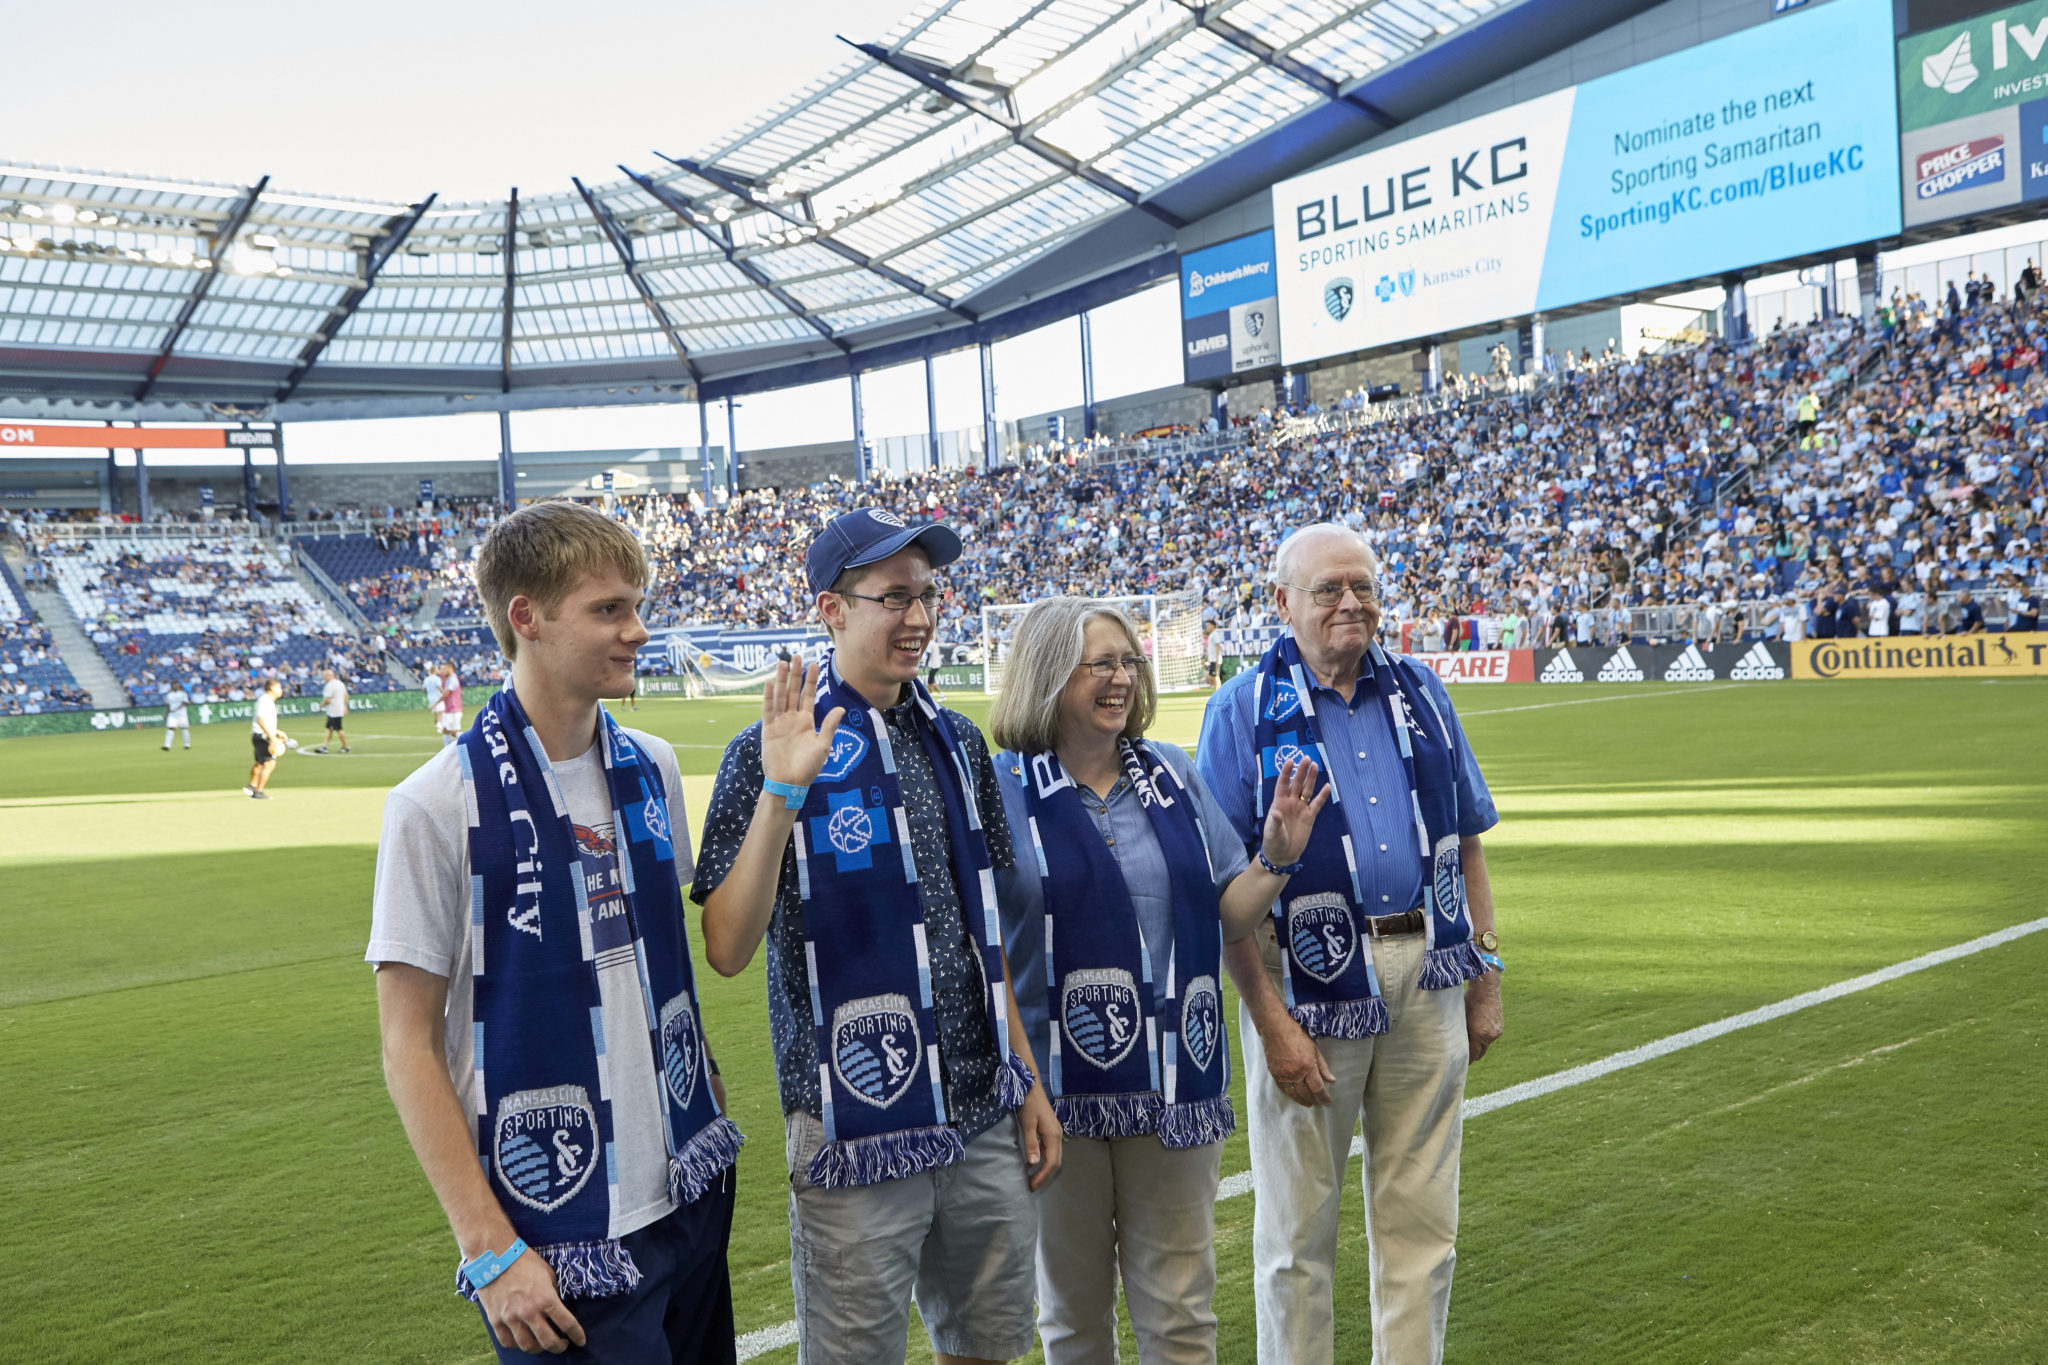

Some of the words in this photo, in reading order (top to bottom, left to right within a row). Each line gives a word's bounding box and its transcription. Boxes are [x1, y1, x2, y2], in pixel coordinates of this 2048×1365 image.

[1614, 111, 1715, 156] Nominate
[1722, 98, 1757, 126] the
[1764, 79, 1815, 113] next
[1611, 156, 1698, 195] Sporting
[1704, 121, 1821, 169] Samaritan
[1920, 143, 1972, 178] PRICE
[1920, 151, 2003, 198] CHOPPER
[1297, 165, 1432, 242] BLUE
[1451, 136, 1528, 198] KC
[1580, 144, 1864, 240] SportingKC.com/BlueKC
[1299, 231, 1390, 272] SPORTING
[1396, 192, 1530, 246] SAMARITANS
[1243, 260, 1270, 277] Mercy
[1423, 265, 1472, 288] Kansas
[1475, 257, 1504, 275] City
[1188, 334, 1228, 354] UMB
[1427, 656, 1506, 678] CARE
[1810, 639, 1988, 678] Continental
[969, 673, 983, 685] BE
[1540, 670, 1584, 684] adidas
[1597, 668, 1644, 683] adidas
[1664, 668, 1715, 682] adidas
[1730, 666, 1785, 681] adidas
[219, 708, 251, 719] LIVE
[276, 705, 305, 715] ELL.
[349, 699, 378, 710] ELL.
[586, 872, 604, 892] HE
[1291, 896, 1322, 912] KANSAS
[1324, 893, 1341, 905] CITY
[1294, 907, 1344, 932] SPORTING
[1068, 970, 1108, 986] KANSAS
[1110, 969, 1129, 984] CITY
[838, 998, 882, 1020] KANSAS
[884, 995, 905, 1010] CITY
[1070, 985, 1130, 1008] SPORTING
[841, 1014, 907, 1045] SPORTING
[504, 1089, 556, 1113] KANSAS
[558, 1087, 582, 1103] CITY
[505, 1107, 583, 1140] SPORTING
